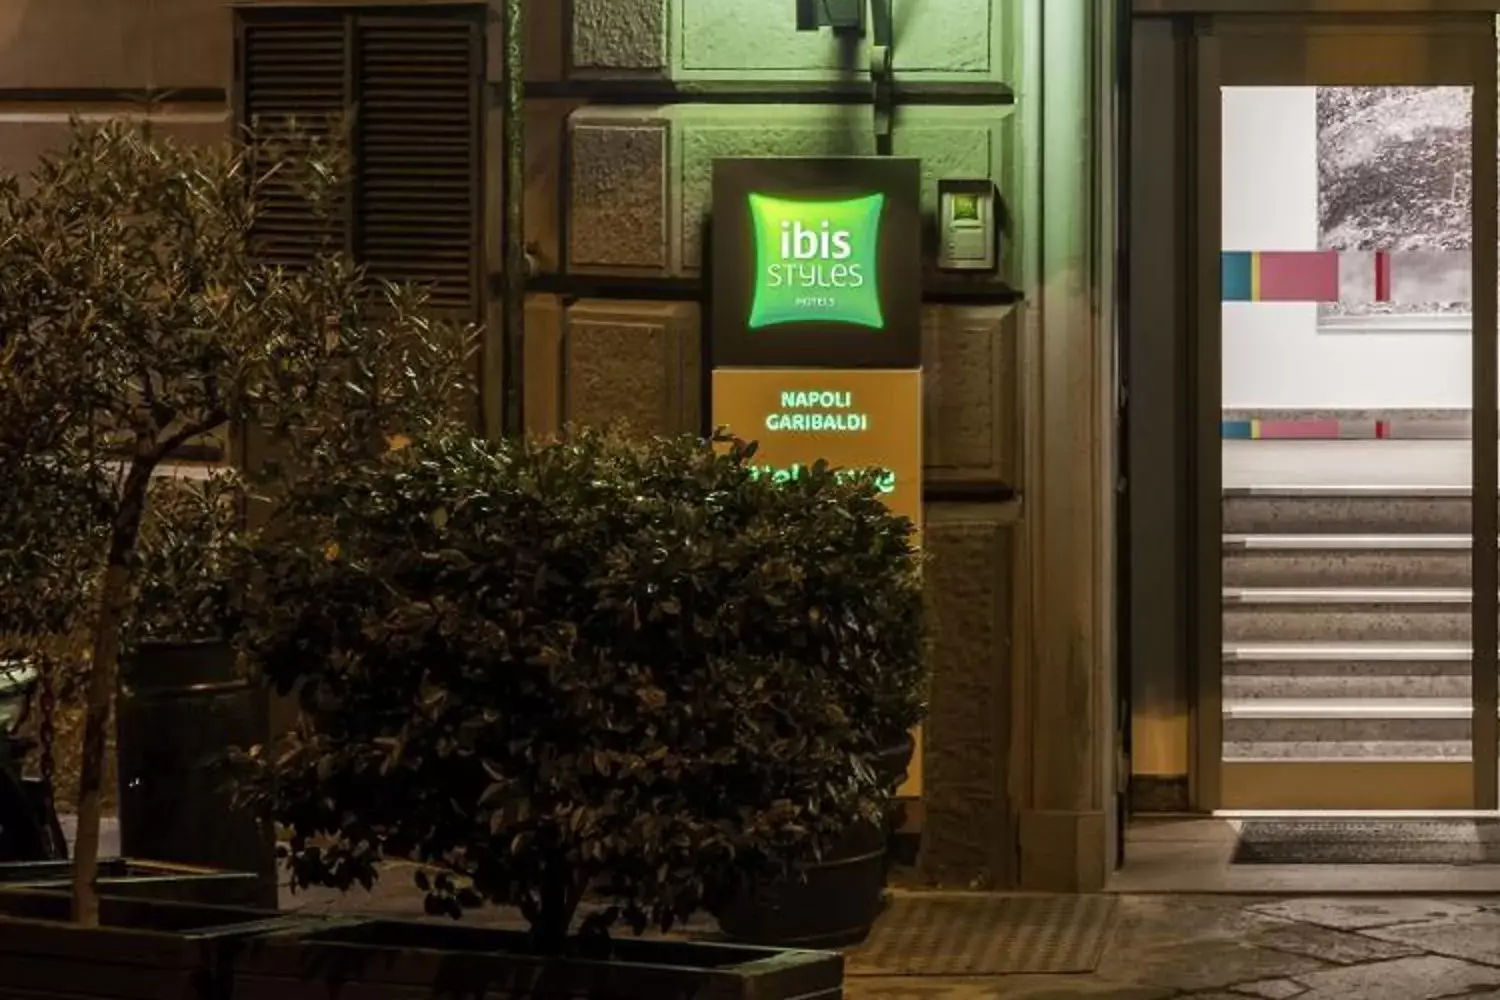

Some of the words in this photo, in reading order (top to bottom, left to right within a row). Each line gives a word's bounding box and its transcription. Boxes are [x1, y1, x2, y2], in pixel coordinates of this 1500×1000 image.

[780, 220, 851, 259] ibis
[781, 391, 851, 408] NAPOLI
[766, 414, 867, 431] GARIBALDI
